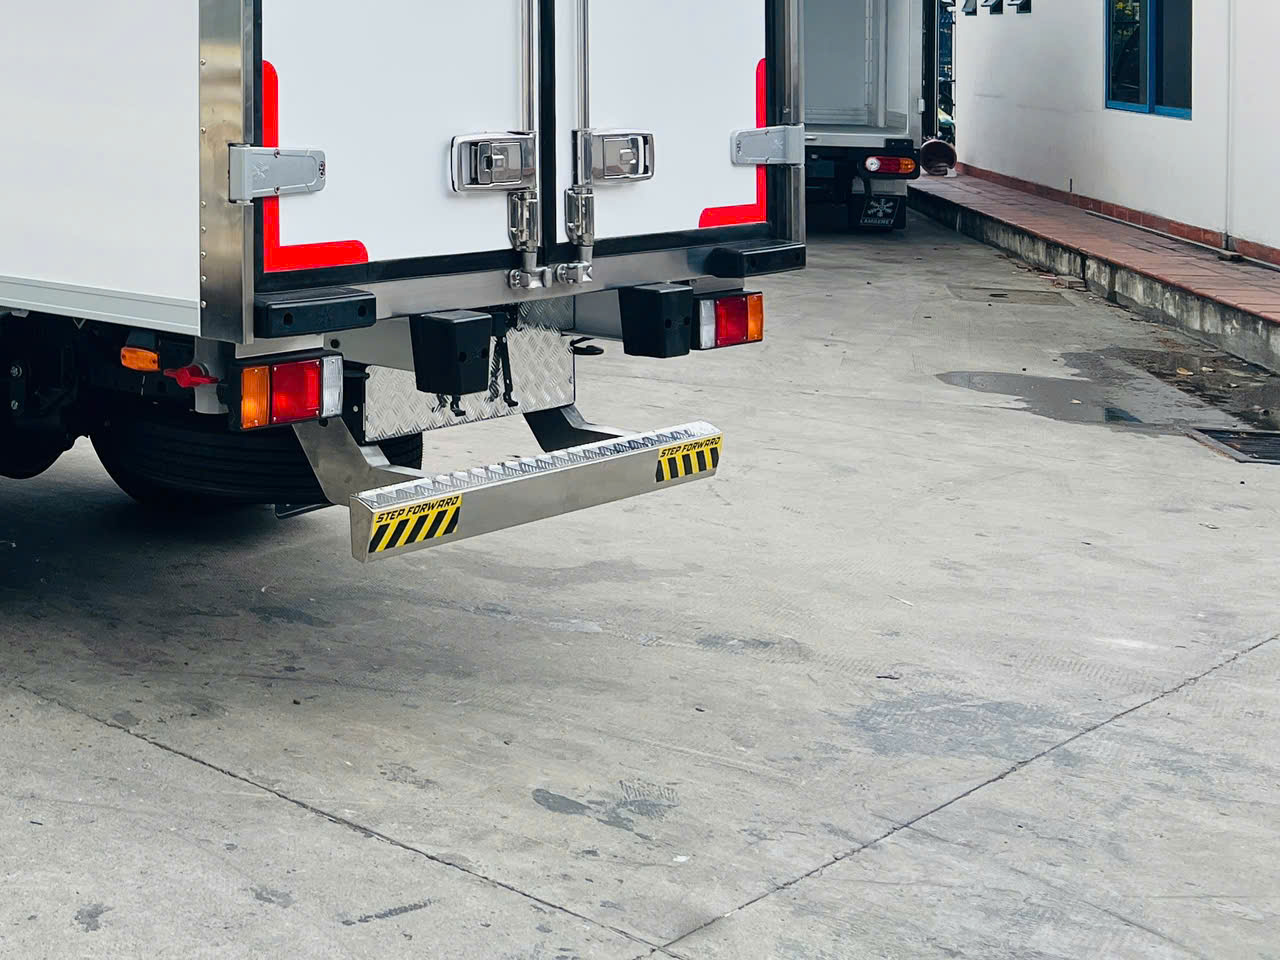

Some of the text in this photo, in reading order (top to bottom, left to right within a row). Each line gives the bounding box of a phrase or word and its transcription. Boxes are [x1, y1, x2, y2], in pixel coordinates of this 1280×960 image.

[659, 436, 721, 458] STEP FORWARD
[376, 495, 460, 524] STEP FORWARD
